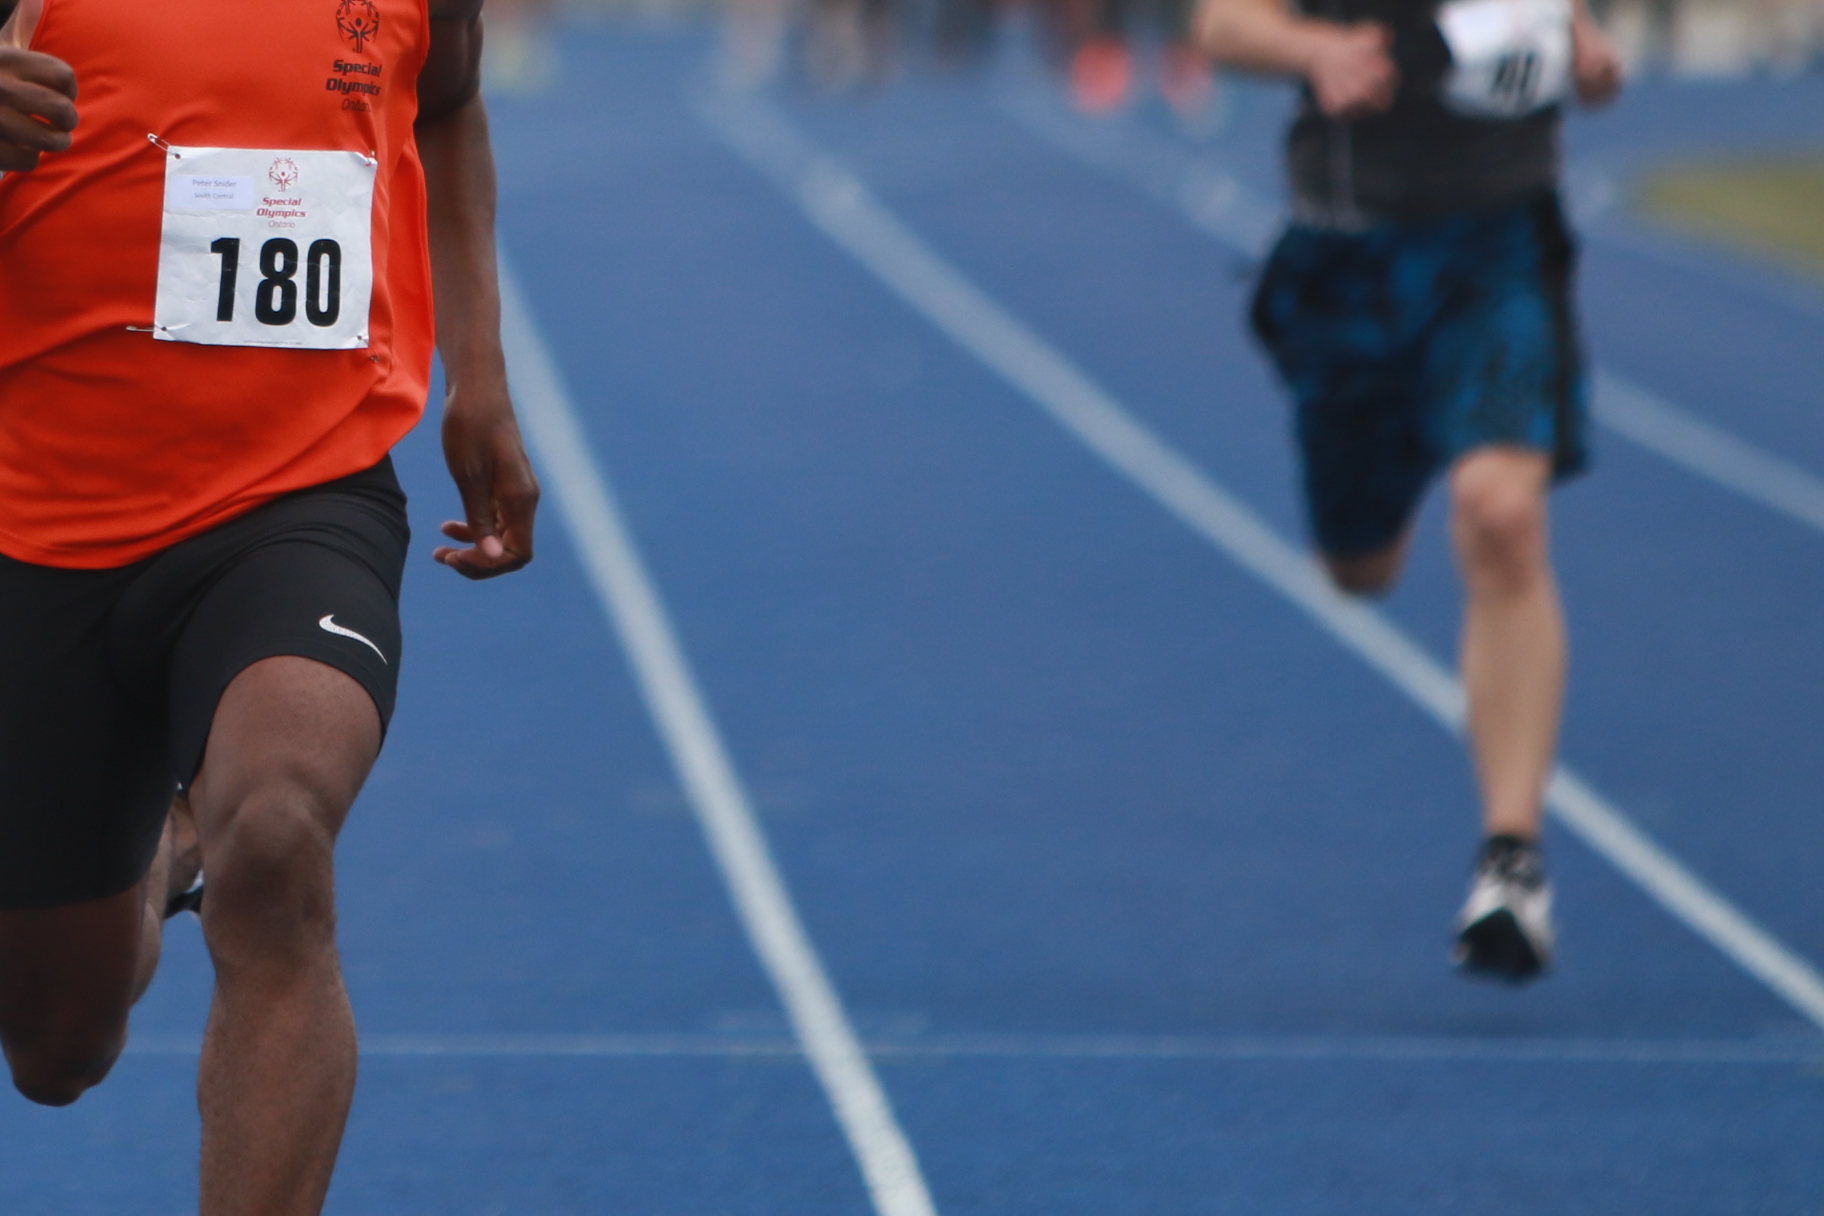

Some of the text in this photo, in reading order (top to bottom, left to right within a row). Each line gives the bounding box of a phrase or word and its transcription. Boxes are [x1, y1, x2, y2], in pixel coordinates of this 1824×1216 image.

[332, 59, 382, 77] Special
[325, 78, 381, 96] Olympics
[192, 179, 212, 187] Peter
[262, 197, 302, 207] Special
[256, 208, 306, 218] Olympics
[268, 220, 296, 228] Ontario
[210, 237, 342, 327] 180
